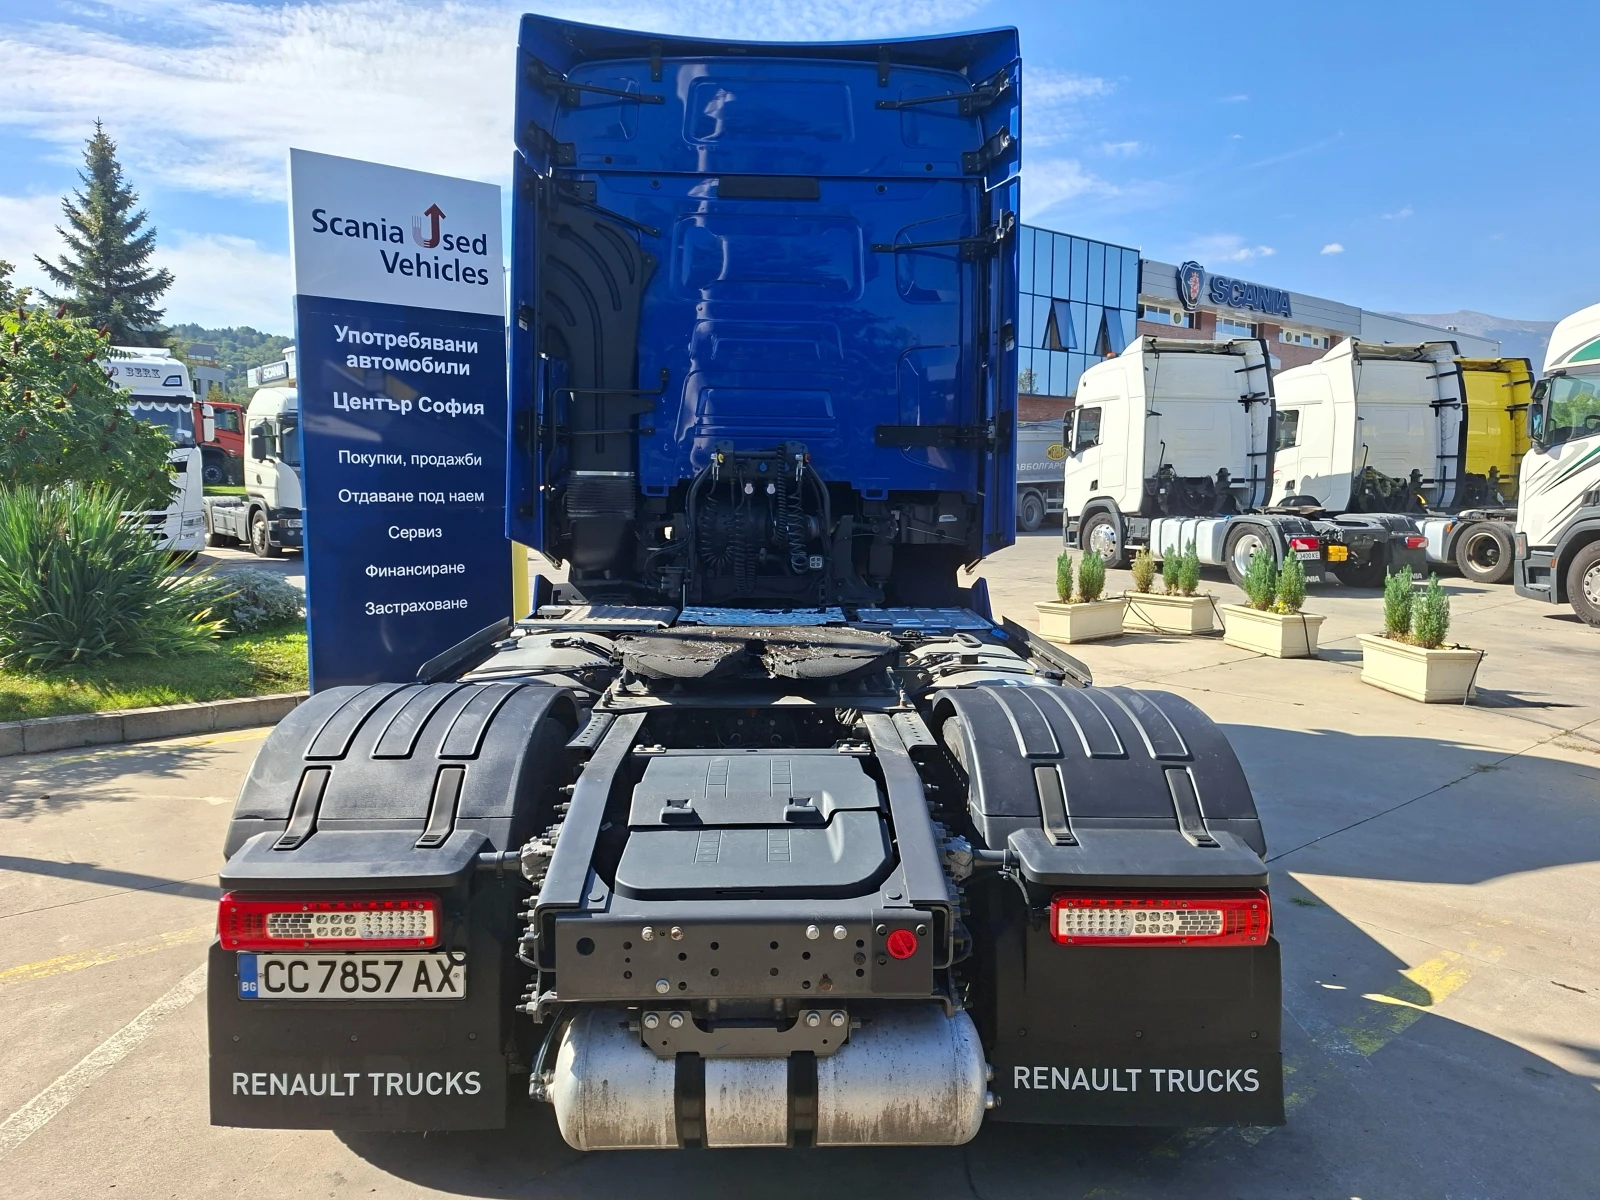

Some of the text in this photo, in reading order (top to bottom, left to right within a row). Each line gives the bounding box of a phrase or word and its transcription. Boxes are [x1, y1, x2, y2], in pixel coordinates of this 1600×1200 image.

[311, 208, 404, 244] Scania
[379, 249, 489, 286] Vehicles
[1208, 276, 1293, 318] SCANIA
[333, 324, 479, 354] Употребявани
[263, 364, 285, 379] SCANIA
[346, 353, 471, 376] автомобили
[333, 391, 485, 418] Център София
[338, 450, 482, 468] Покупки, продажби
[338, 489, 485, 504] Отдаване под наем
[388, 526, 442, 541] Сервиз
[365, 562, 466, 578] Финансиране
[365, 598, 468, 616] Застраховане
[241, 981, 257, 992] BG
[264, 960, 457, 993] CC 7857 AX
[232, 1071, 481, 1096] RENAULT TRUCKS
[1013, 1066, 1260, 1092] RENAULT TRUCKS
